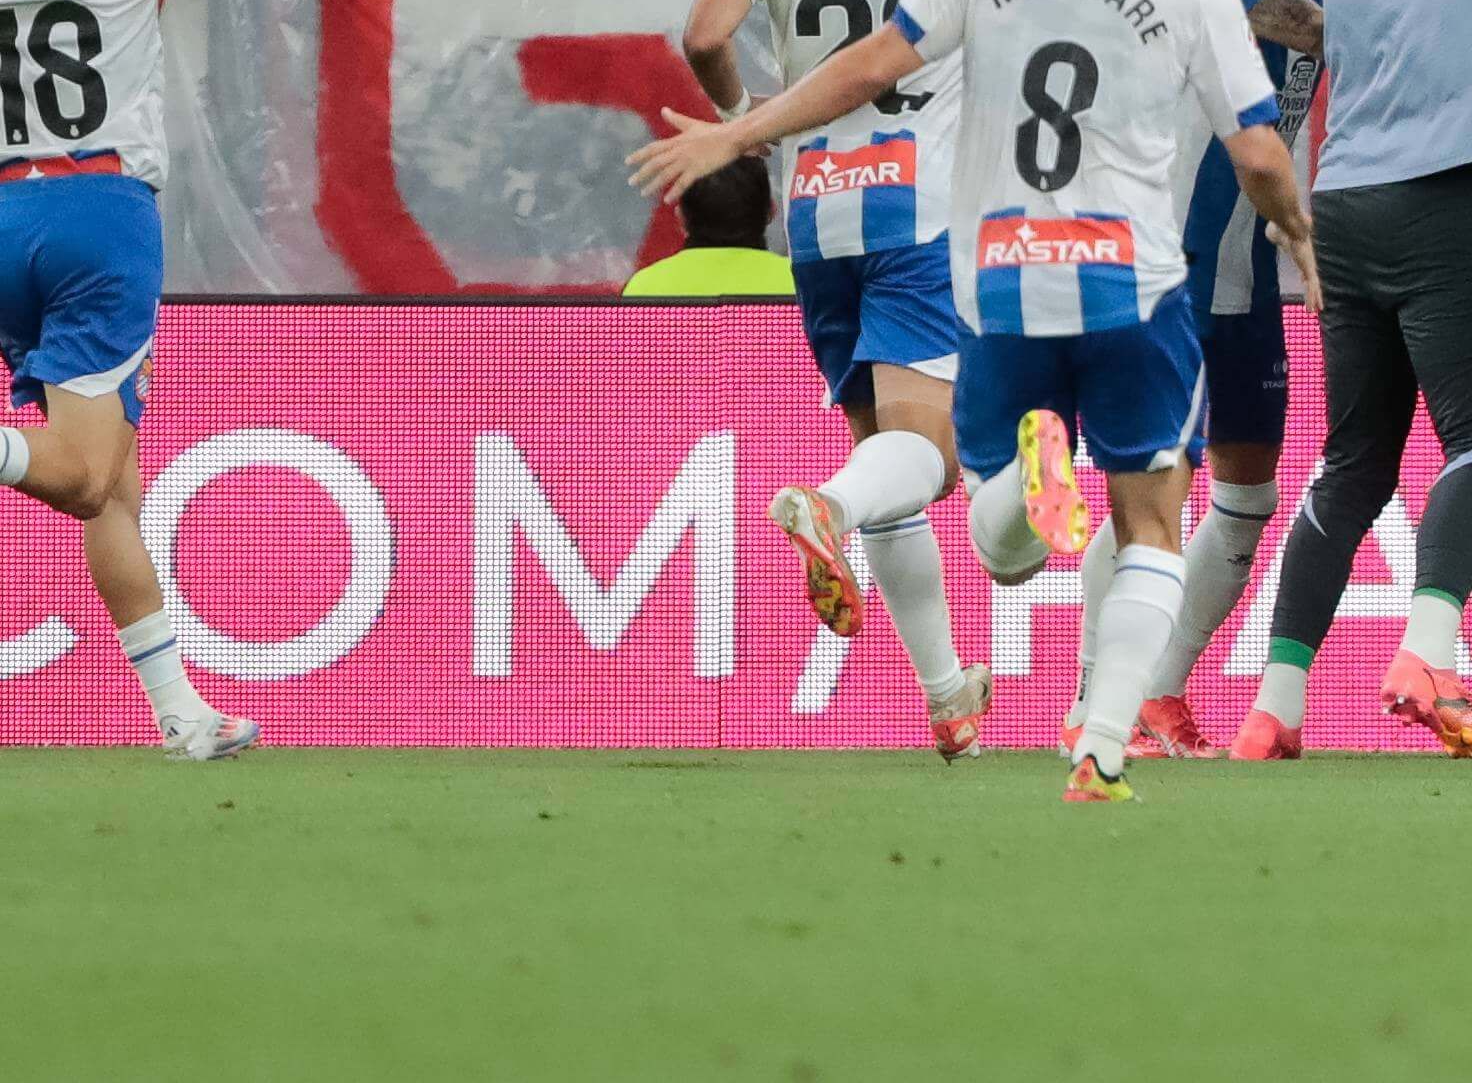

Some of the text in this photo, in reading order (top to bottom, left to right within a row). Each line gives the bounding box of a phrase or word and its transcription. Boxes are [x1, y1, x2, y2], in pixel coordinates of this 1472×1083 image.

[0, 0, 108, 146] 18
[1014, 40, 1100, 193] 8
[793, 160, 901, 197] RASTAR
[983, 237, 1120, 266] RASTAR
